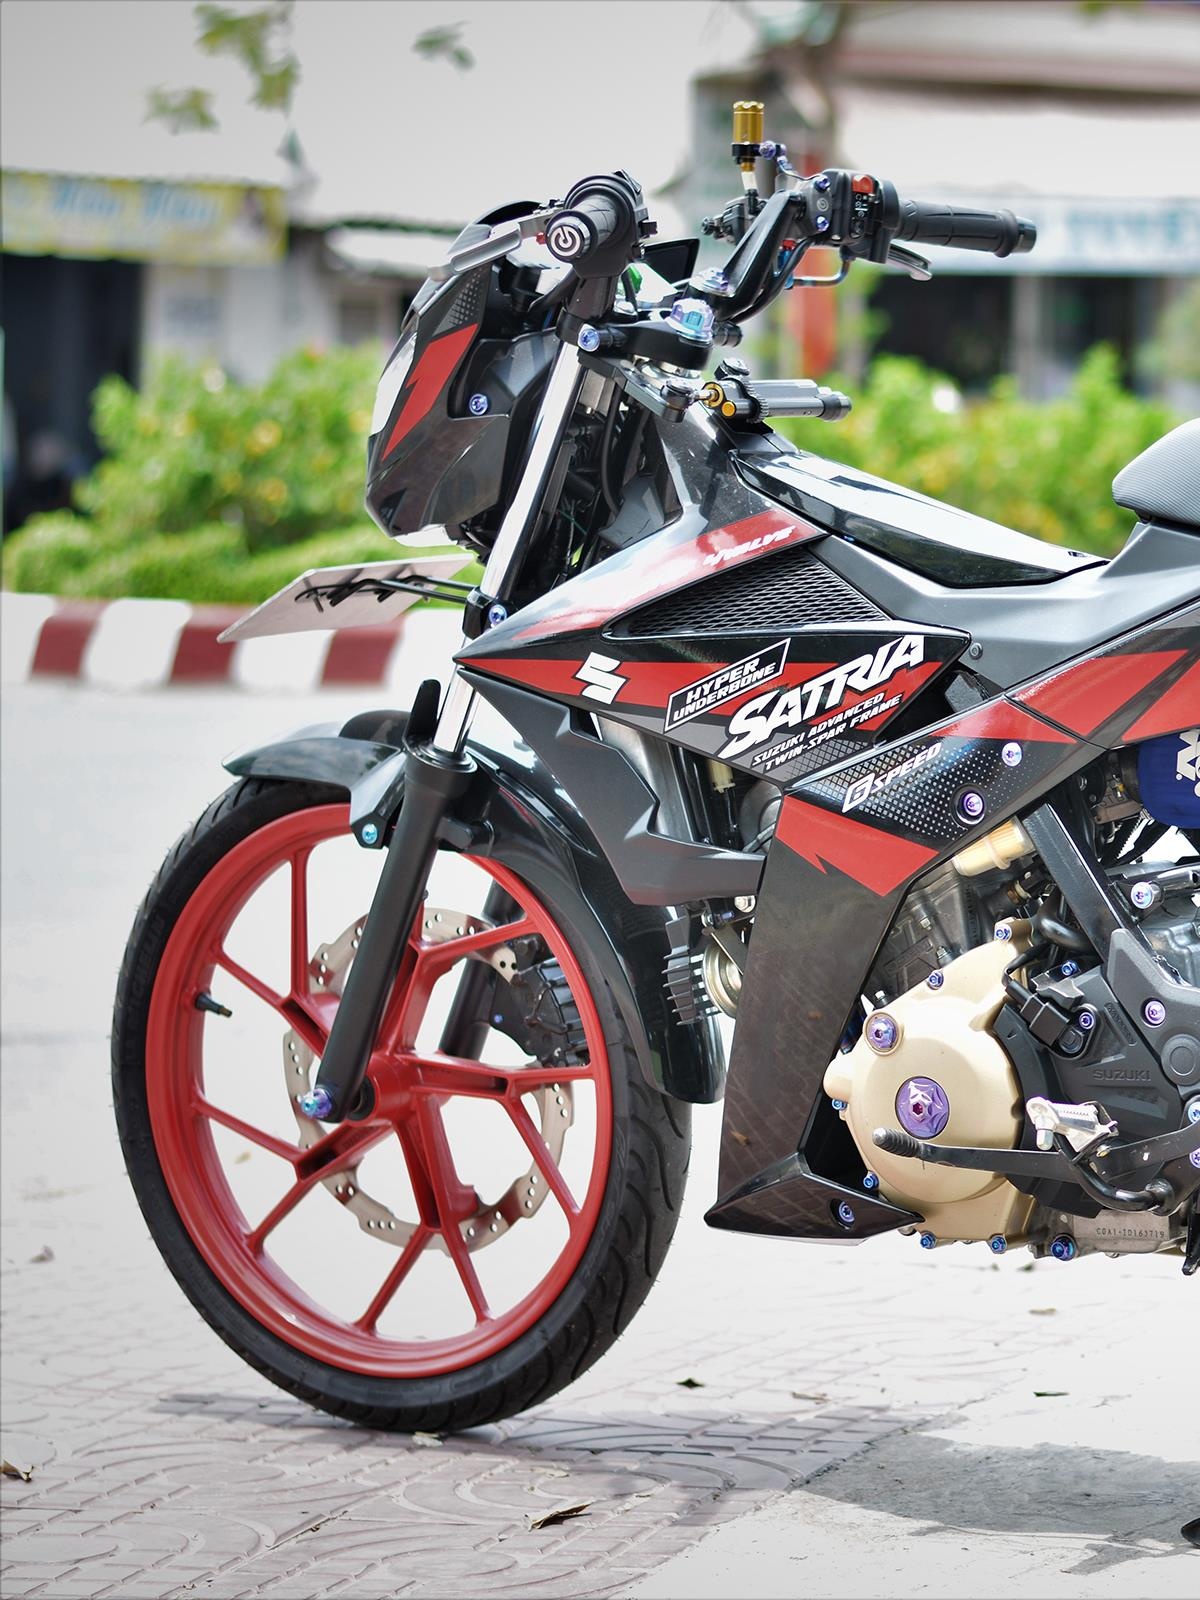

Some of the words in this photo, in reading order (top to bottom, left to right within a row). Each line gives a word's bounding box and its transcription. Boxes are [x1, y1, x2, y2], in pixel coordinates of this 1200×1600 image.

[673, 662, 777, 722] UNDERBONE
[686, 657, 760, 703] HYPER
[717, 635, 925, 759] SATRIA
[752, 732, 804, 766] SUZUKI
[808, 692, 885, 736] ADVANCED
[764, 724, 846, 771] TWIN-SPAR
[850, 693, 902, 729] FRAME
[1093, 1068, 1152, 1082] SUZUKI
